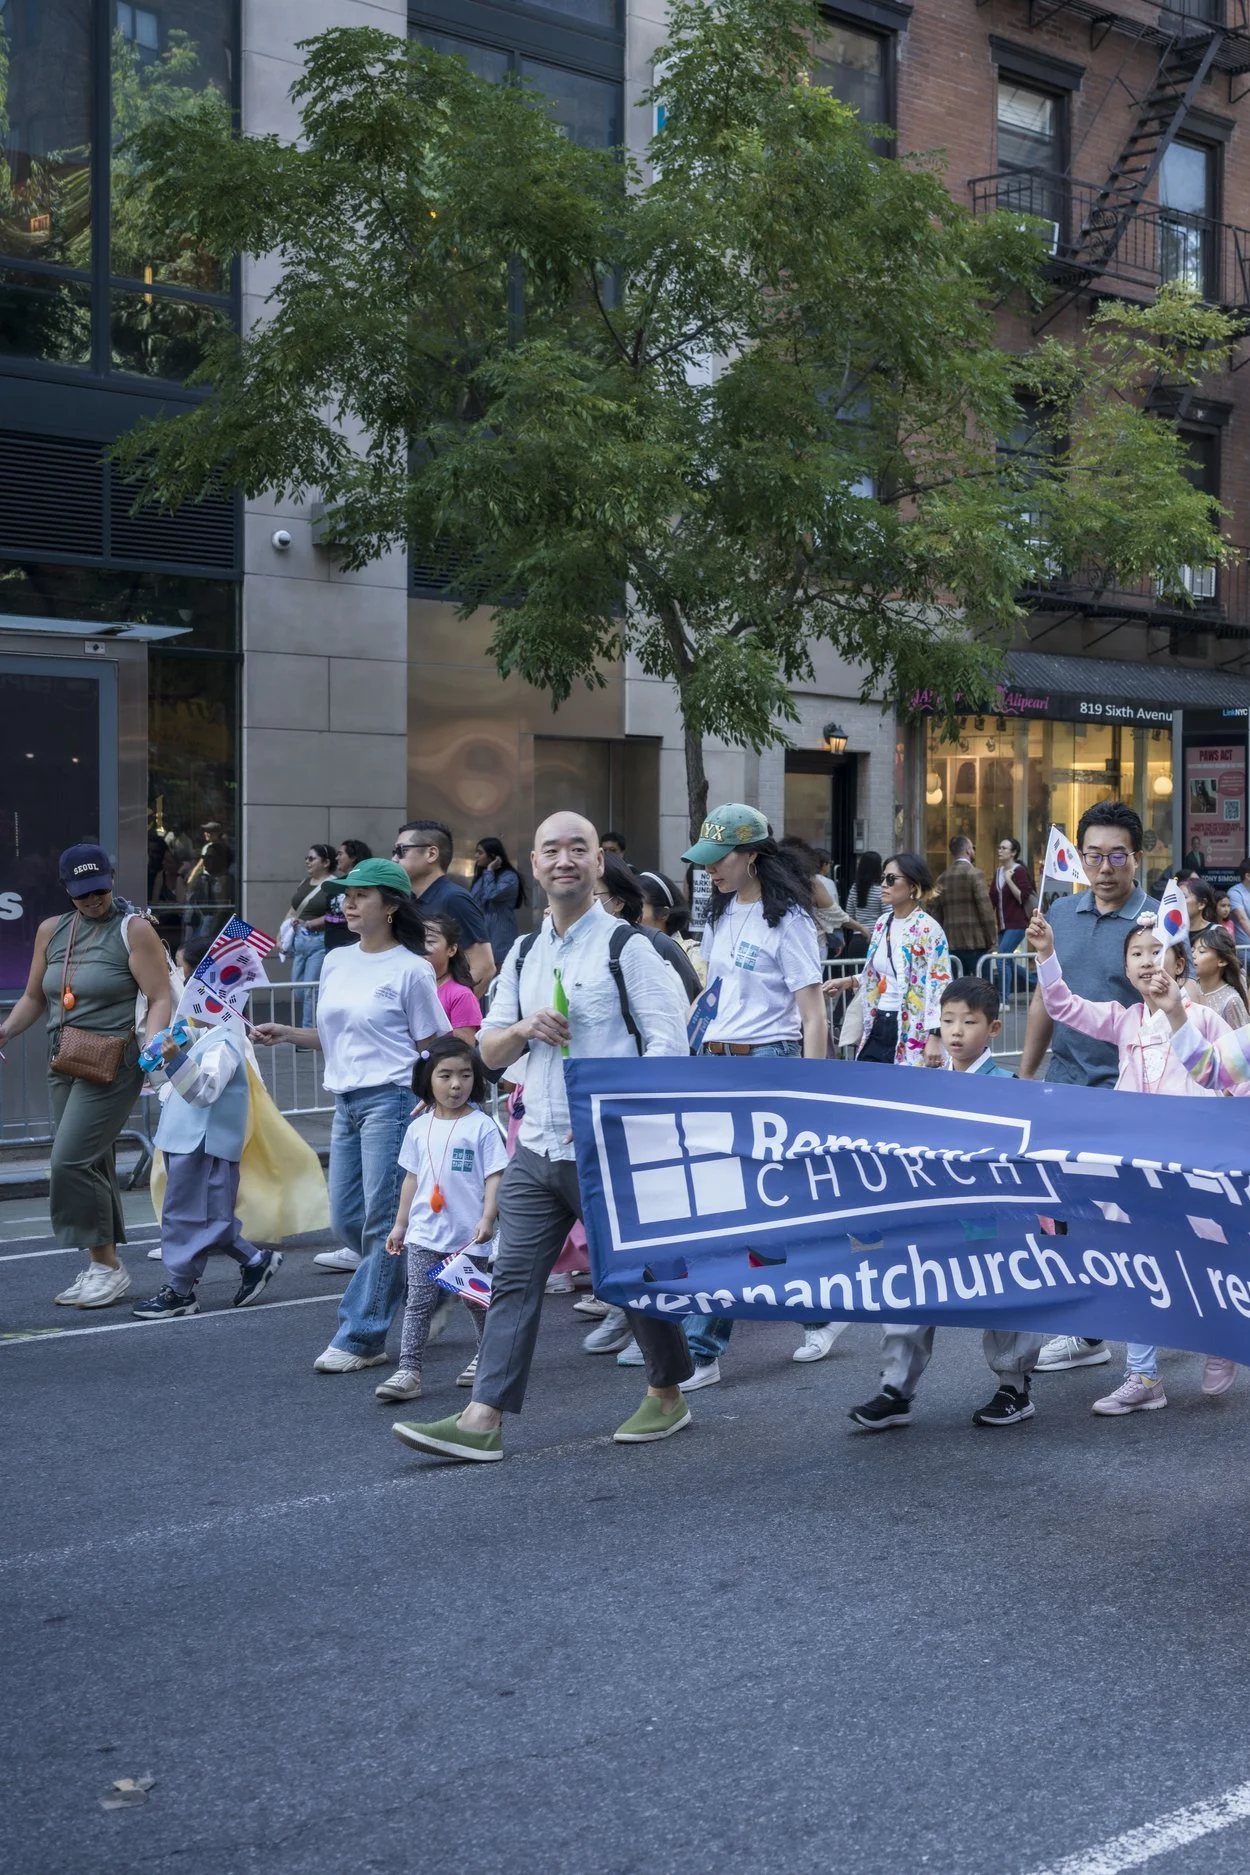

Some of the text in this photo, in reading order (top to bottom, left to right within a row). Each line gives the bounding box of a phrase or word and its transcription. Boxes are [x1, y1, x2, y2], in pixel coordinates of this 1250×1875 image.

[1080, 702, 1173, 722] 819 Sixth Avenu
[1223, 708, 1248, 717] LinkNYC
[1200, 750, 1233, 761] PAWS ACT
[73, 863, 99, 877] SEOUL
